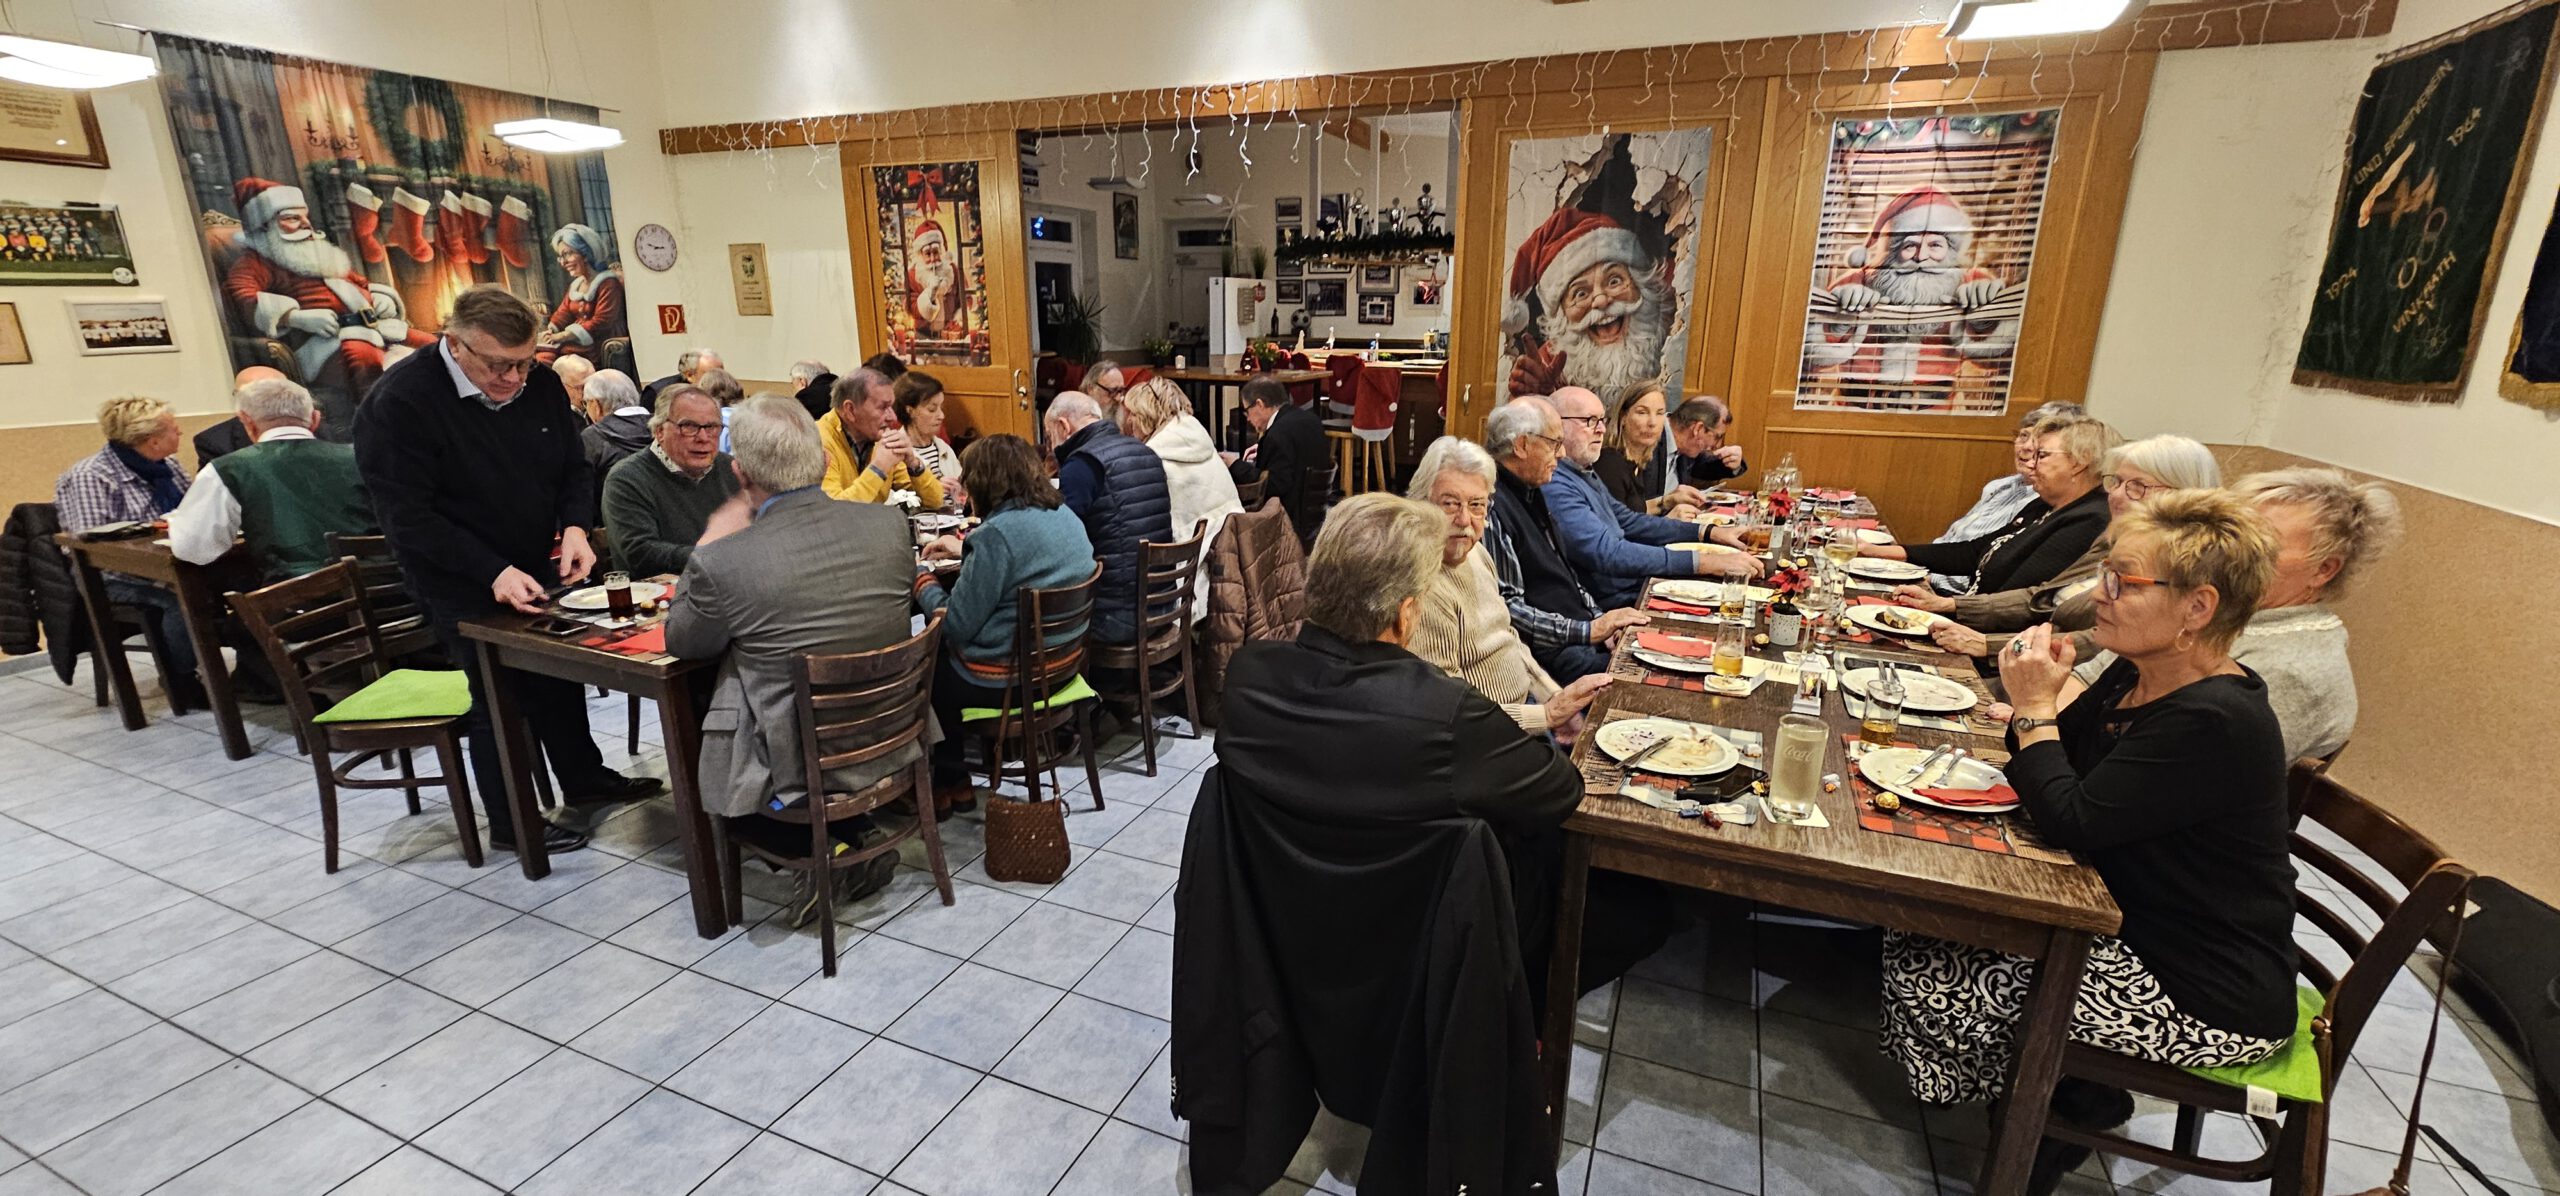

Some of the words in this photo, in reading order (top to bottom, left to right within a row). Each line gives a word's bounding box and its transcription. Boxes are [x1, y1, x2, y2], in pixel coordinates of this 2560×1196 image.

[2446, 106, 2482, 148] 1964
[2354, 153, 2383, 185] UND
[2325, 266, 2359, 300] 1924
